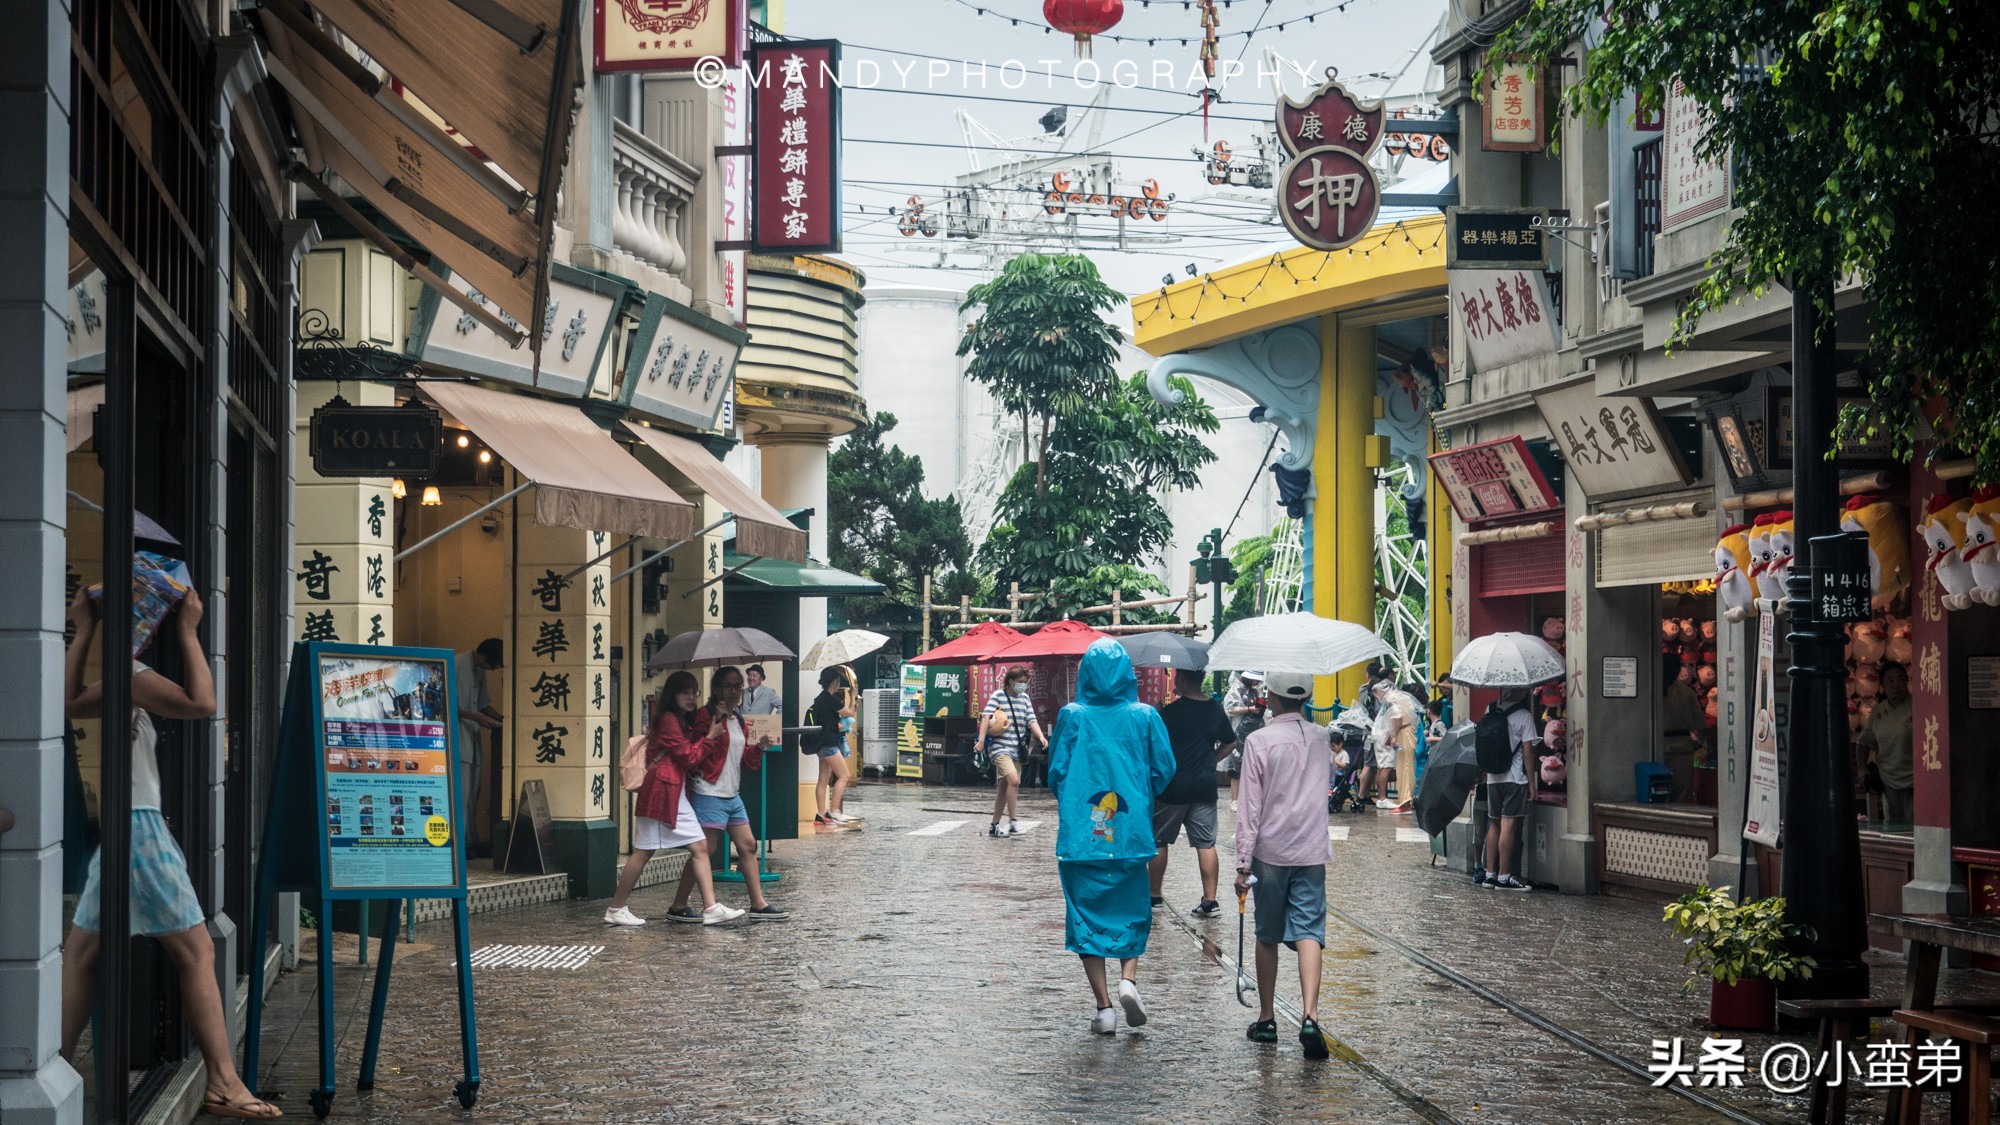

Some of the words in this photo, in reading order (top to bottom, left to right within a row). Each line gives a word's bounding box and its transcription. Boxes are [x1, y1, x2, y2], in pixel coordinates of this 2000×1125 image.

[637, 20, 659, 30] TRADE
[671, 20, 693, 28] MARK
[1297, 111, 1369, 141] 德康
[1495, 117, 1533, 131] 美容店
[1503, 74, 1522, 115] 秀芳
[1294, 158, 1365, 238] 押
[1461, 230, 1538, 245] 亞楊樂器
[1460, 271, 1541, 341] 德康大押
[649, 333, 725, 402] 奇華餅家
[332, 428, 426, 449] KOALA
[1560, 405, 1657, 467] 冠軍文具
[706, 542, 719, 618] 著名
[1454, 543, 1468, 697] 德康
[1568, 530, 1585, 767] 德康大押
[530, 568, 572, 764] 奇華餅家
[934, 672, 960, 693] 陽光
[1727, 702, 1736, 783] BAR
